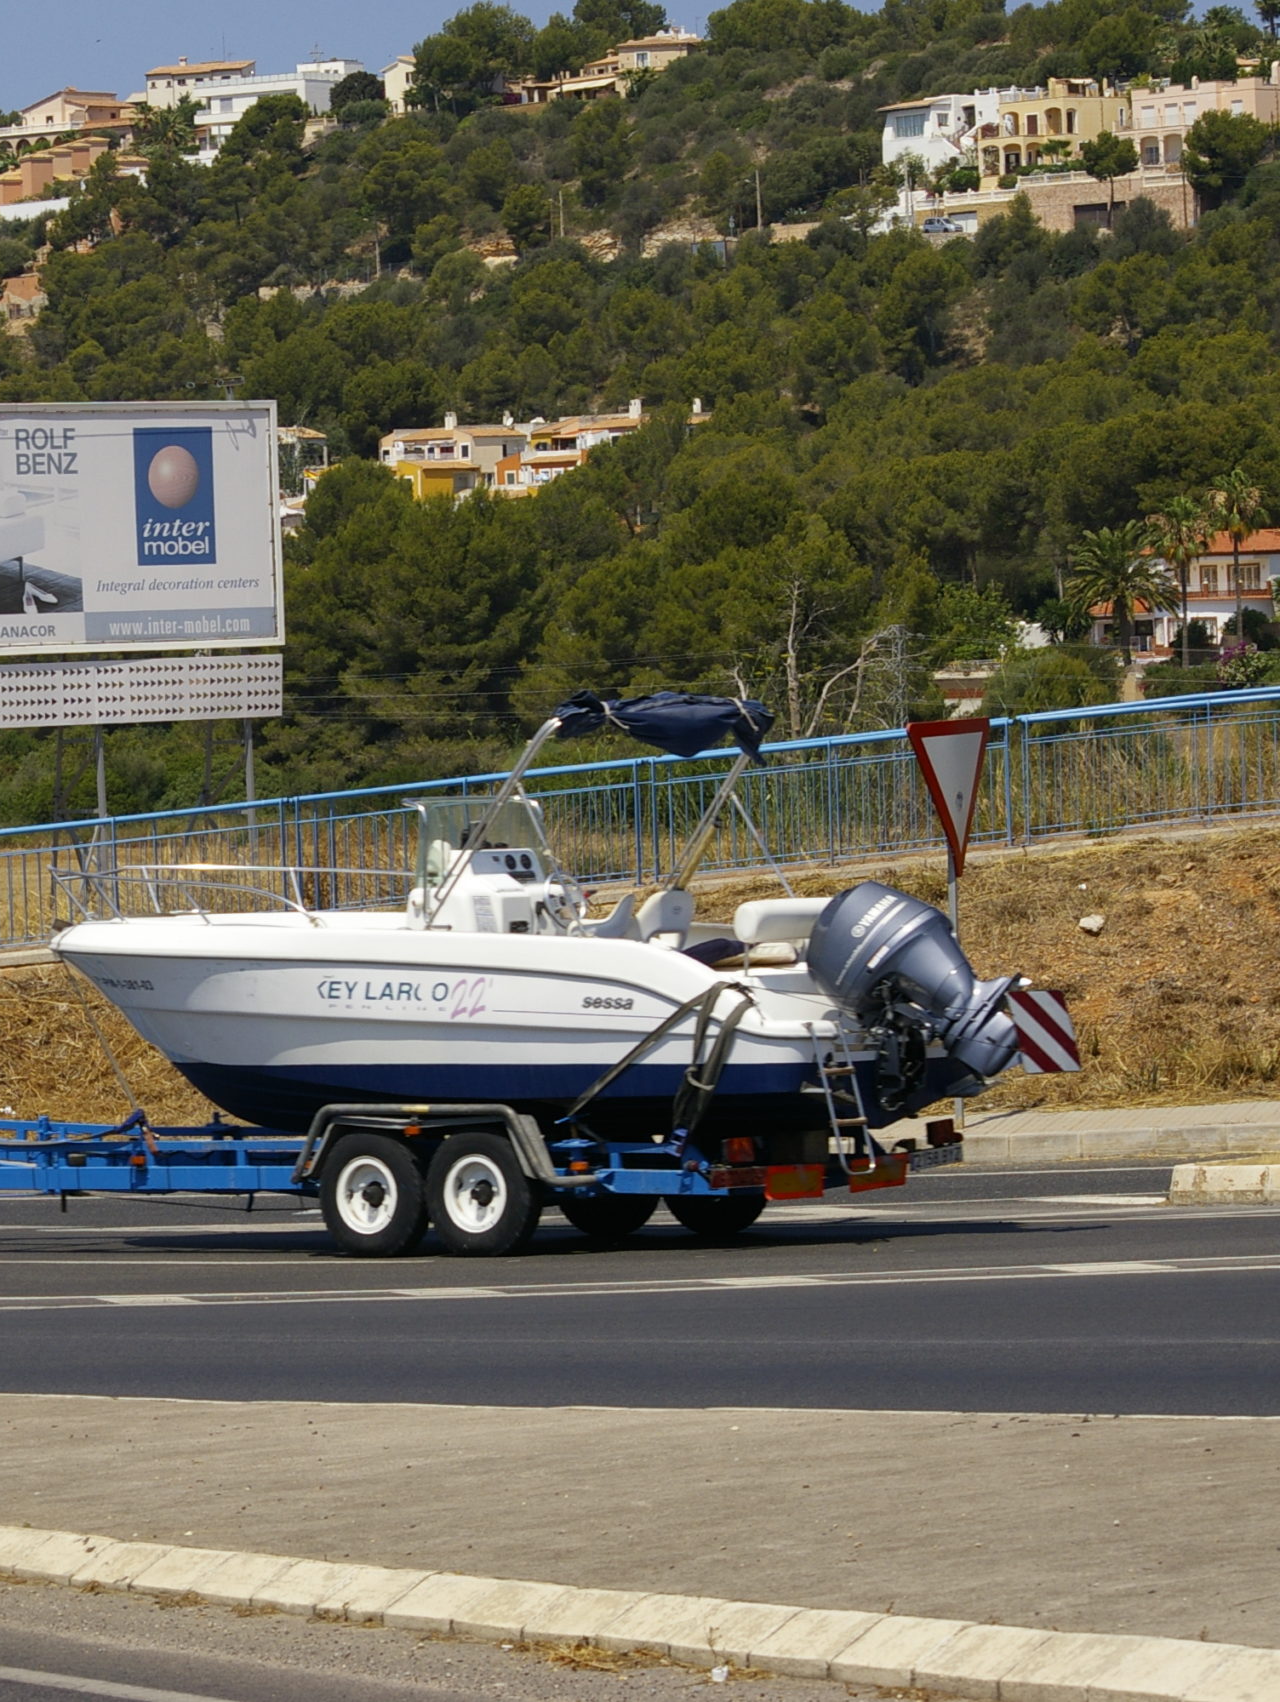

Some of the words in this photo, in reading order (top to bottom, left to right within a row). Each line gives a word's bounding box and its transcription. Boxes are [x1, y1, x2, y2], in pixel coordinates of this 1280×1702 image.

[15, 428, 76, 450] ROLF
[16, 452, 79, 475] BENZ
[142, 518, 211, 538] inter
[144, 536, 210, 556] mobel
[96, 578, 145, 596] Integral
[148, 577, 214, 592] decoration
[217, 576, 260, 590] centers
[109, 614, 251, 637] www.inter-mobel.com
[581, 996, 635, 1011] sessa
